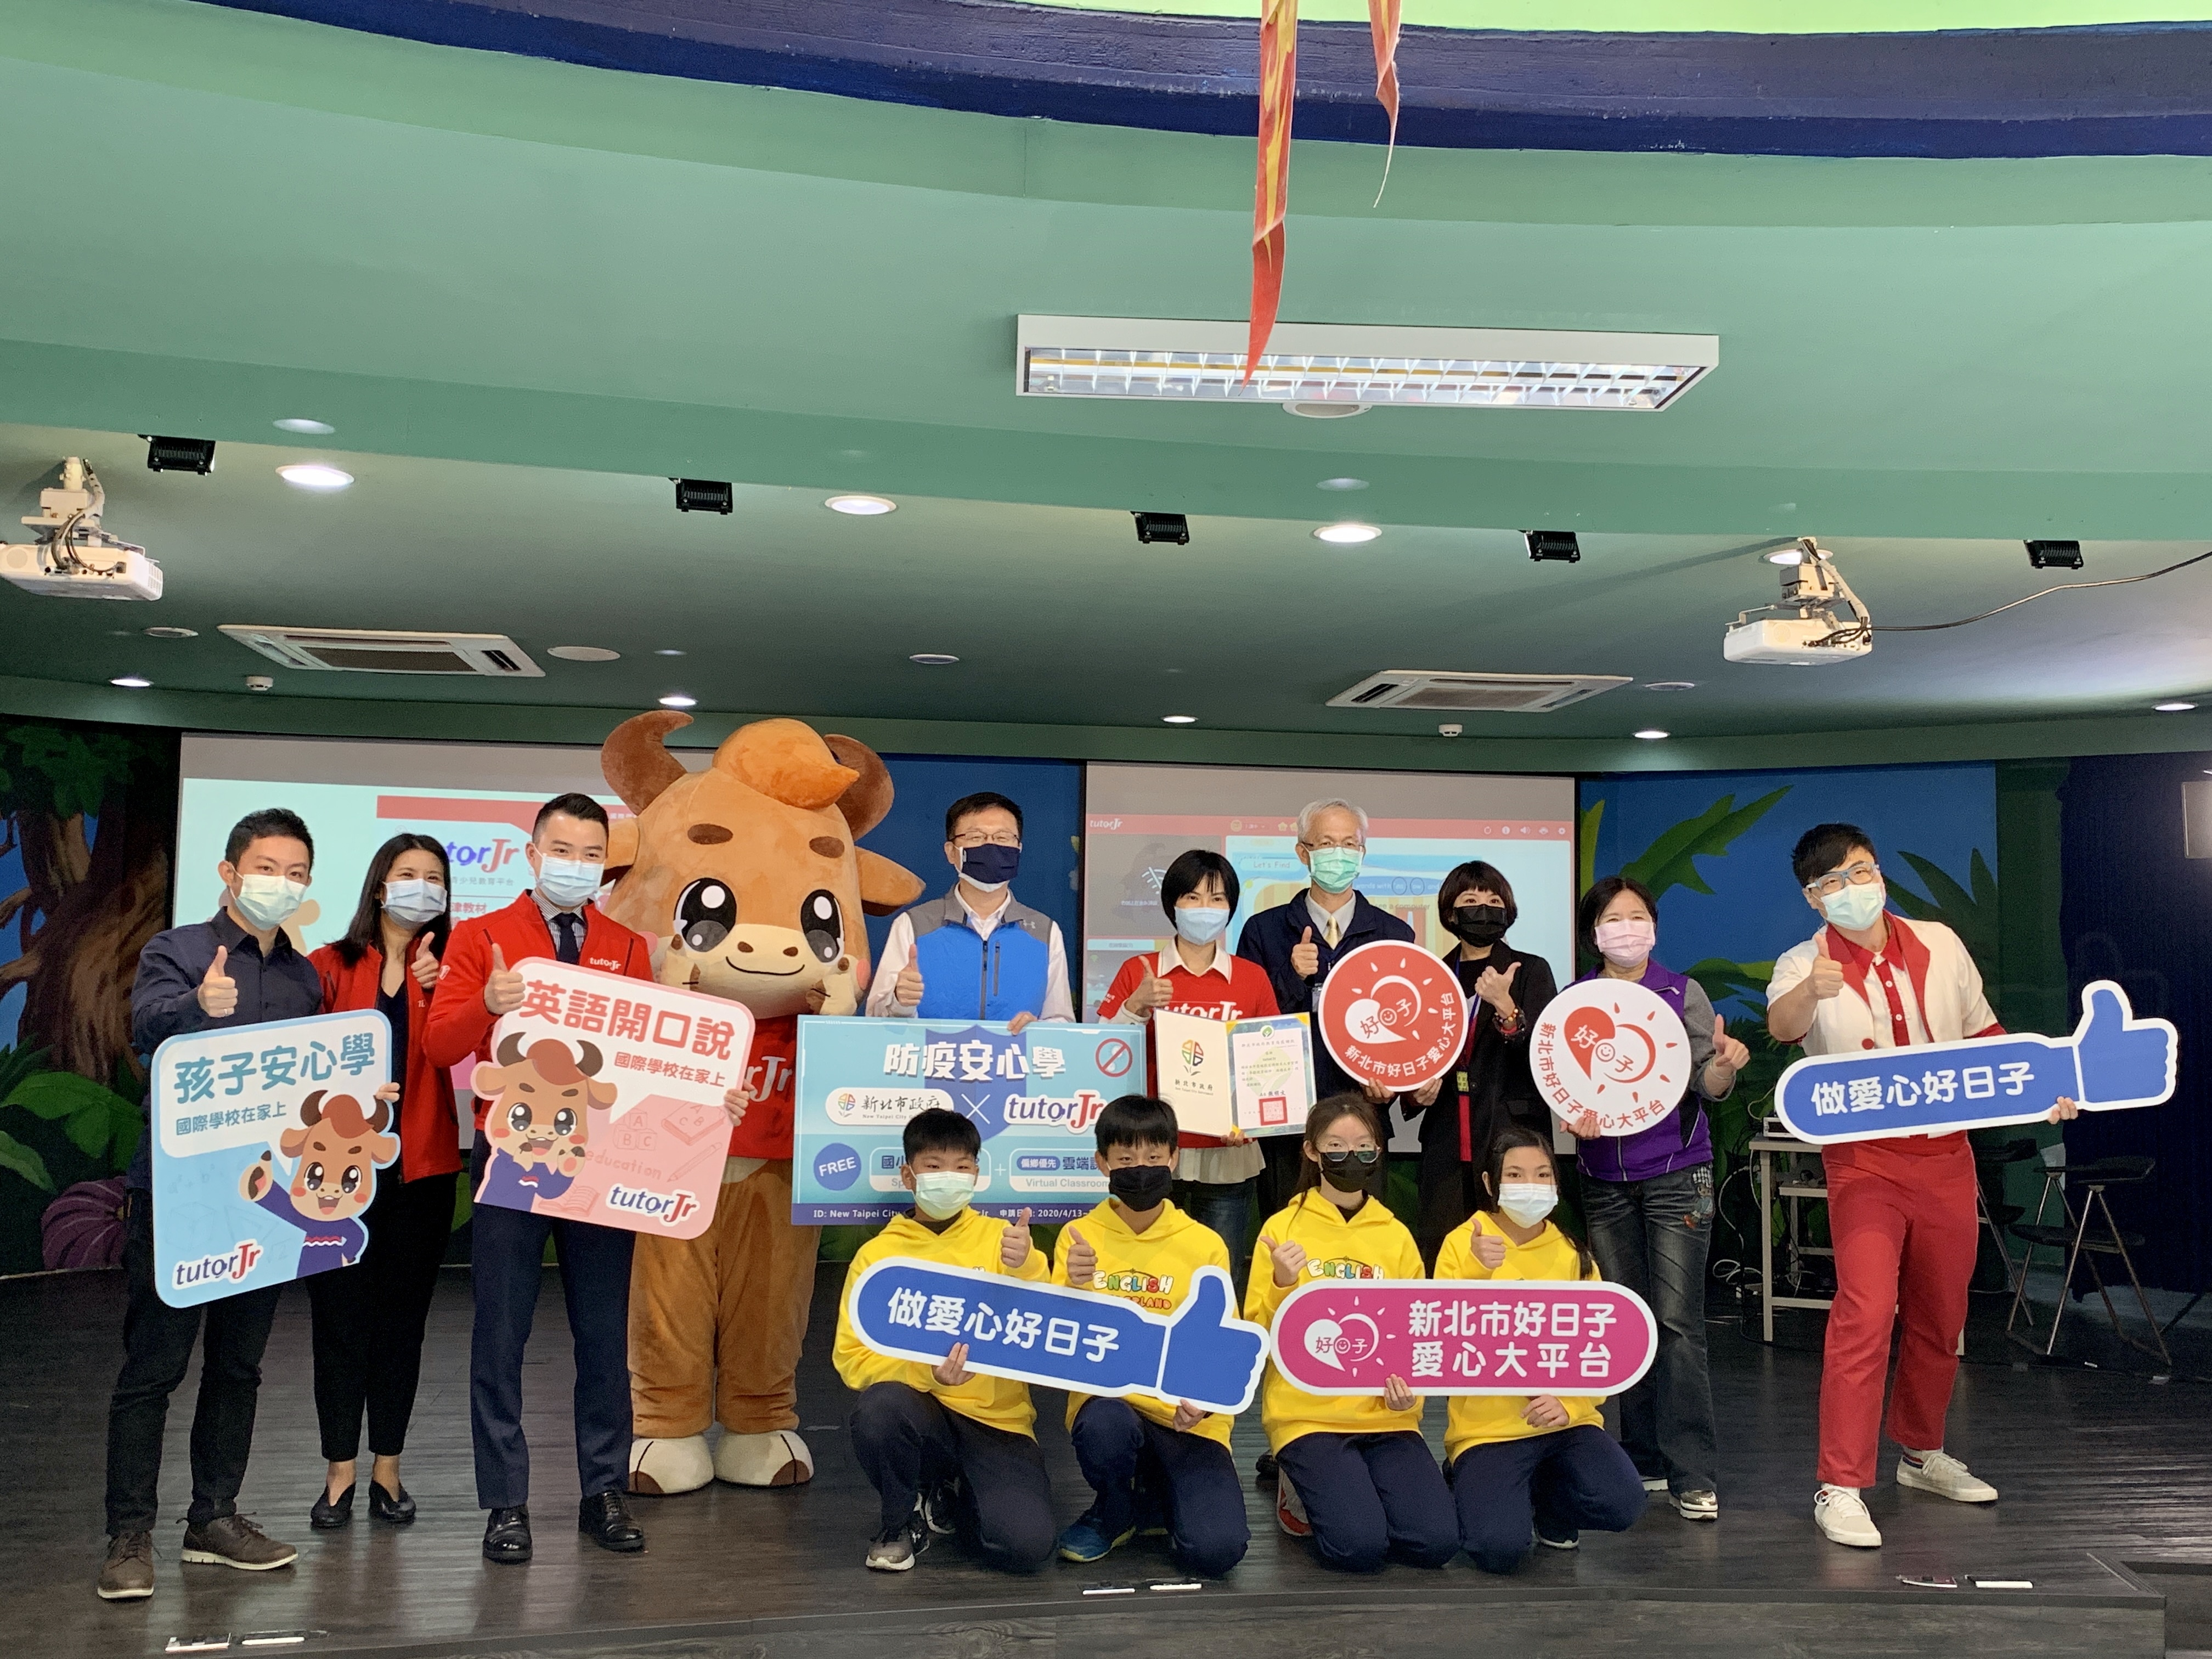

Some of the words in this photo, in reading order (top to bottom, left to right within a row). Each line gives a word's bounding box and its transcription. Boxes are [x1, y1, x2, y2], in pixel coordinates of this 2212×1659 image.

[589, 957, 621, 970] tutorJr
[519, 980, 735, 1060] 英語開口說
[174, 1032, 375, 1104] 孩子安心學
[614, 1052, 726, 1087] 國際學校在家上
[883, 1039, 1066, 1081] 防疫安心學
[1810, 1062, 2035, 1116] 做愛心好日子
[176, 1102, 286, 1136] 國際學校在家上
[1008, 1094, 1104, 1128] tutorJr
[819, 1156, 857, 1177] FREE
[1026, 1178, 1057, 1187] Virtual
[1060, 1178, 1109, 1187] Classroom
[610, 1187, 697, 1223] tutorJr
[853, 1210, 879, 1219] Taipei
[176, 1243, 261, 1285] tutorJr
[1307, 1259, 1385, 1279] ENGLISH
[1093, 1271, 1174, 1295] ENGLISH
[887, 1286, 1120, 1363] 做愛心好日子
[1408, 1300, 1617, 1338] 新北市好日子
[1411, 1341, 1611, 1378] 愛心大平台
